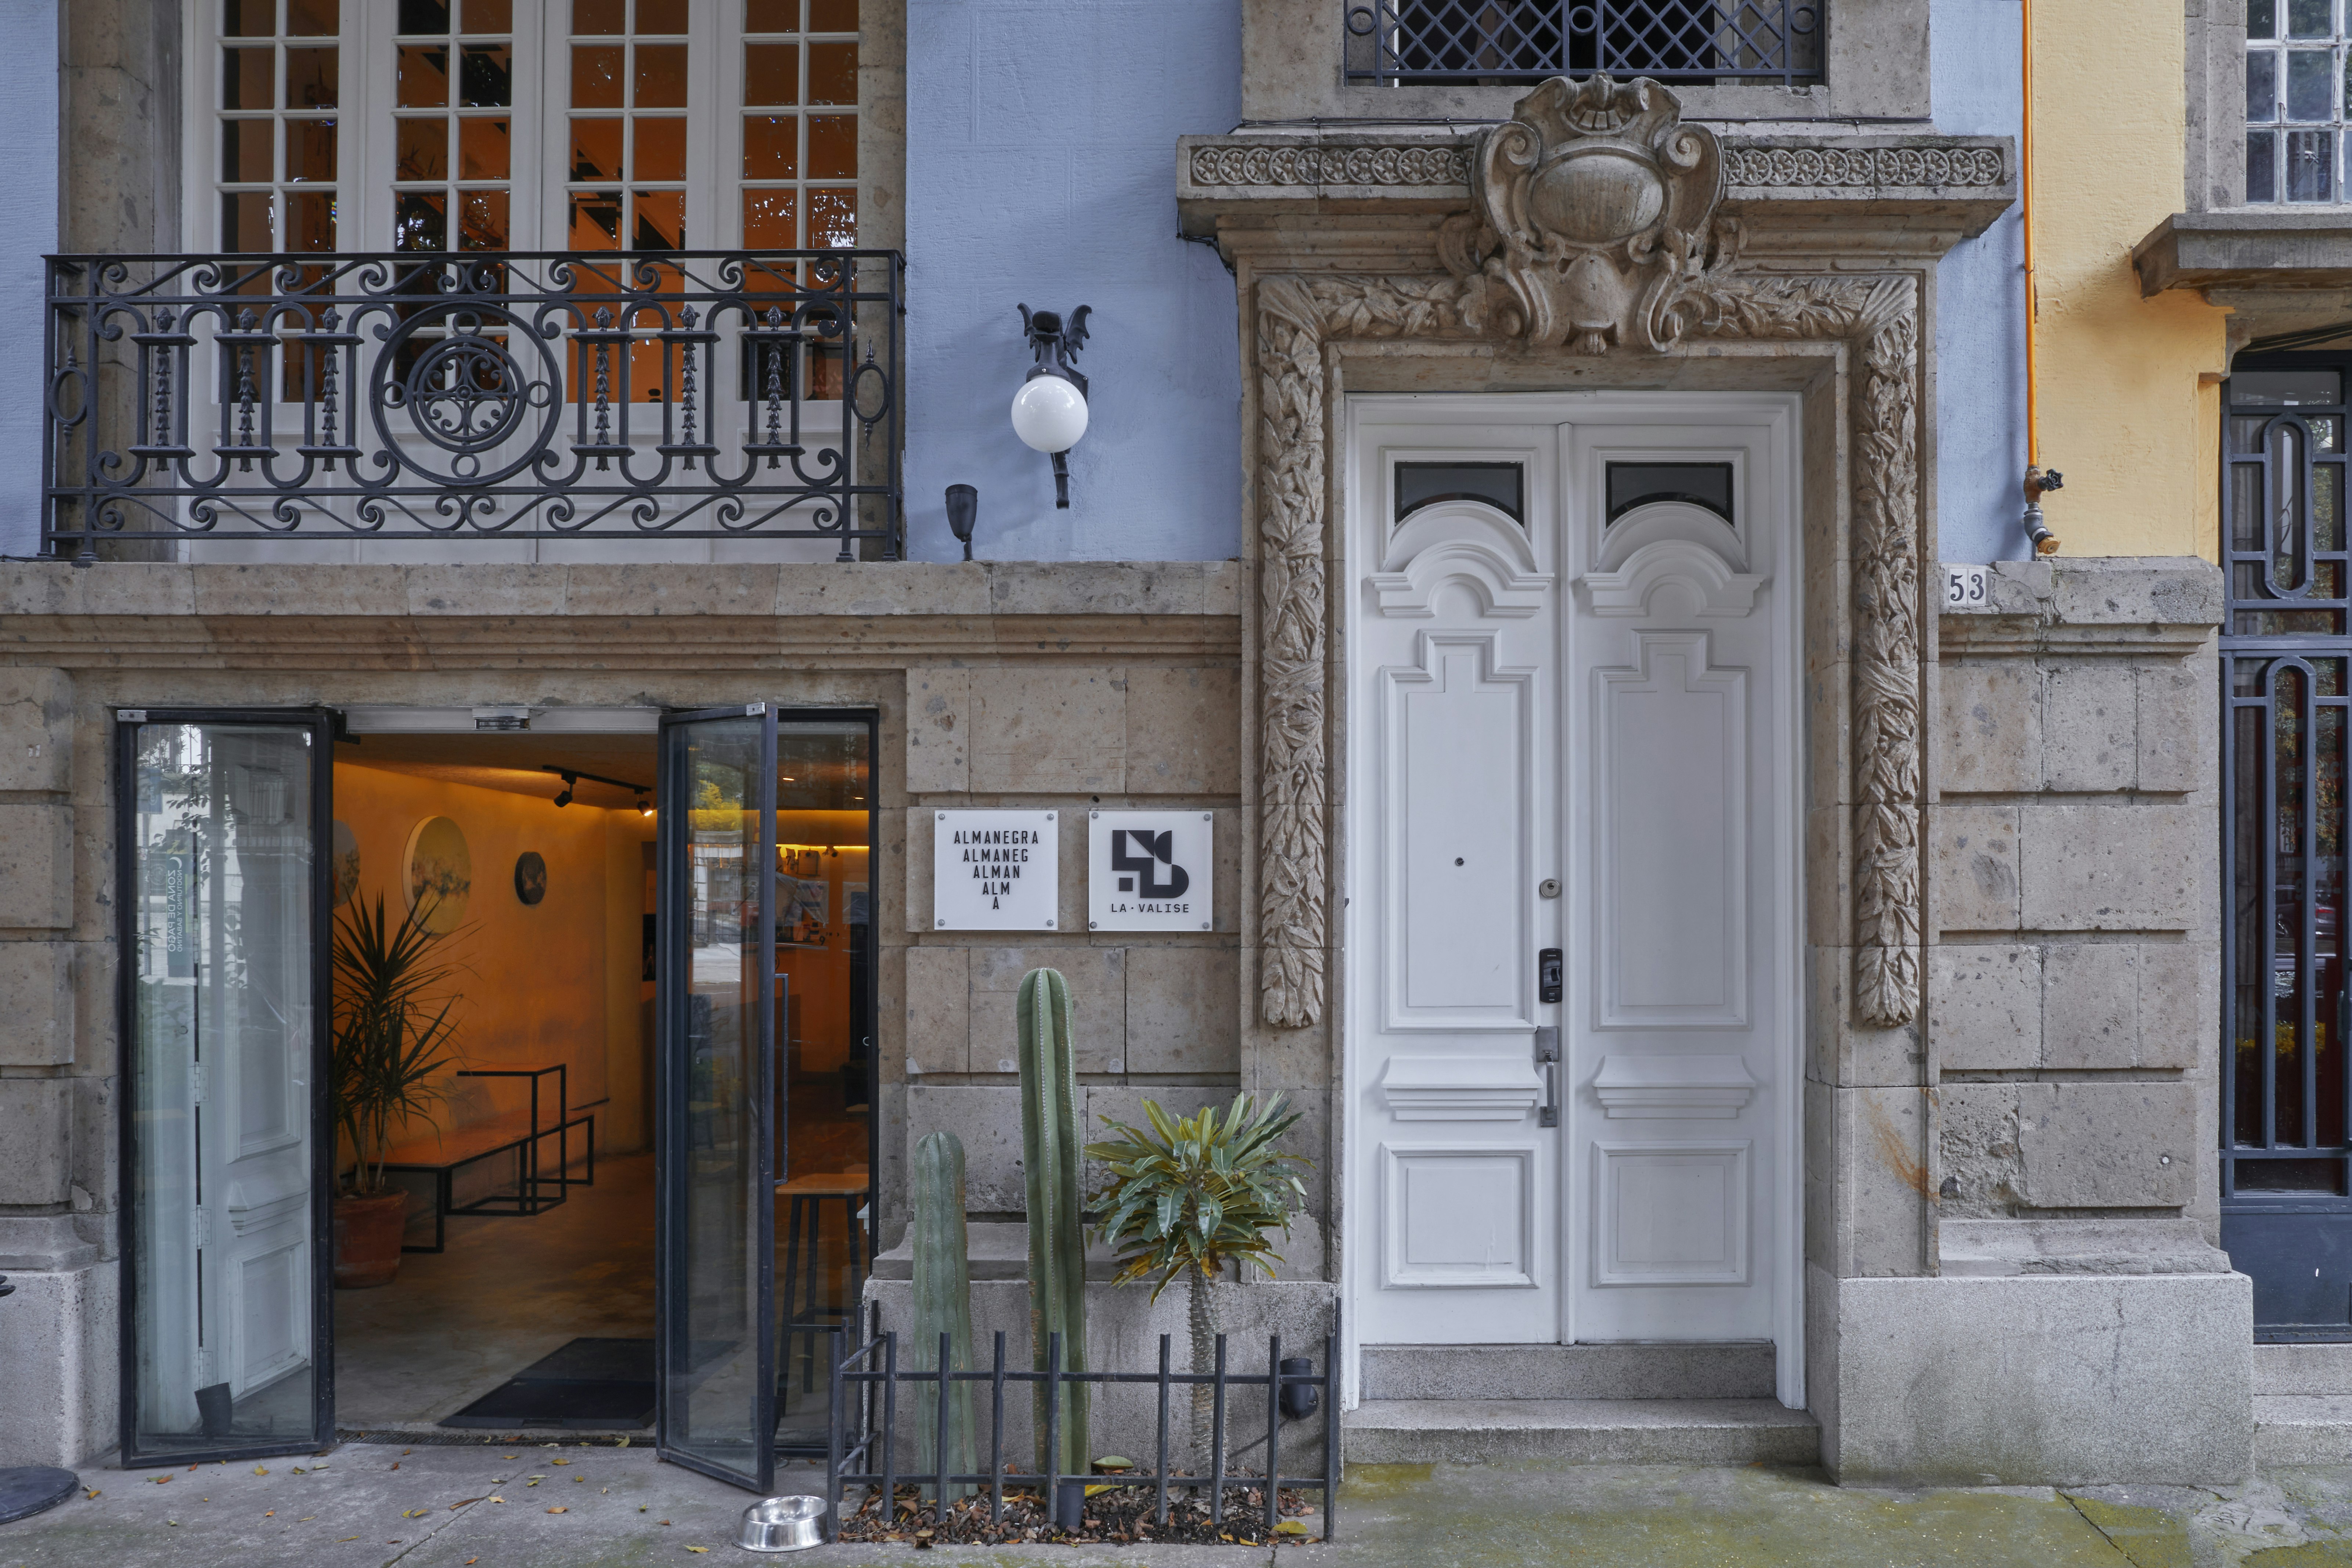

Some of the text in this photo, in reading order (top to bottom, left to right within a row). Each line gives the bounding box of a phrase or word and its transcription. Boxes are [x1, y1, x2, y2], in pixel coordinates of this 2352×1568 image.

[1950, 574, 1984, 601] 53
[954, 830, 1038, 844] ALMANEGRA
[963, 848, 1028, 862] ALMANEG
[973, 865, 1020, 879] ALMAN
[983, 882, 1010, 895] ALM
[993, 896, 999, 909] A
